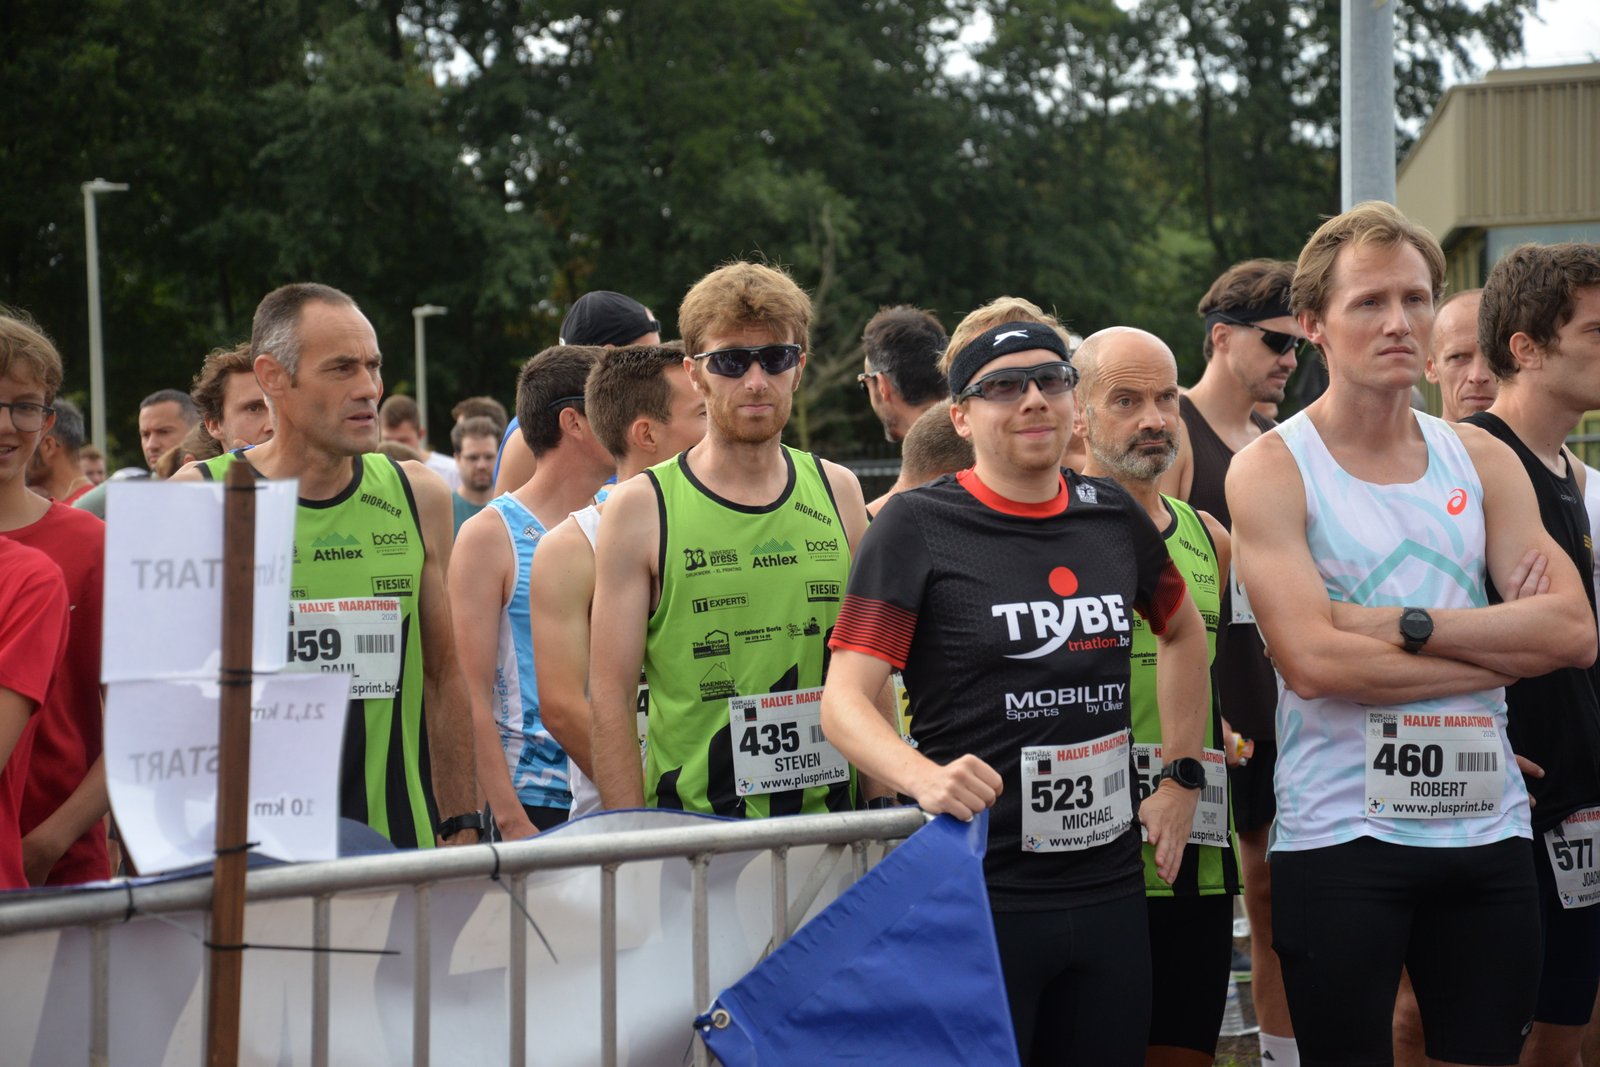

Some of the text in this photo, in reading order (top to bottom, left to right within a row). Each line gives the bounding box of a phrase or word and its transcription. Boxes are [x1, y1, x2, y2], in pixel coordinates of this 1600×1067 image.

[360, 493, 403, 519] BIORACER
[794, 501, 832, 526] BIORACER
[313, 547, 364, 562] Athlex
[710, 554, 738, 566] press
[752, 554, 799, 569] Athlex
[376, 578, 411, 590] FIESIEK
[298, 600, 398, 613] HALVE MARATHON
[694, 596, 747, 613] IT EXPERTS
[734, 628, 765, 637] Containers
[1068, 634, 1130, 652] triatlon.be
[761, 694, 794, 709] HALVE
[1005, 683, 1126, 710] MOBILITY
[1006, 707, 1059, 722] Sports
[1086, 702, 1100, 715] by
[1403, 714, 1494, 728] HALVE MARATHON
[738, 721, 800, 756] 435
[774, 752, 821, 772] STEVEN
[1057, 747, 1090, 762] HALVE
[1373, 743, 1443, 777] 460
[760, 768, 845, 790] www.plusprint.be
[1031, 775, 1094, 813] 523
[1410, 781, 1468, 797] ROBERT
[1393, 800, 1494, 816] www.plusprint.be
[1062, 805, 1114, 830] MICHAEL
[1552, 838, 1593, 871] 577
